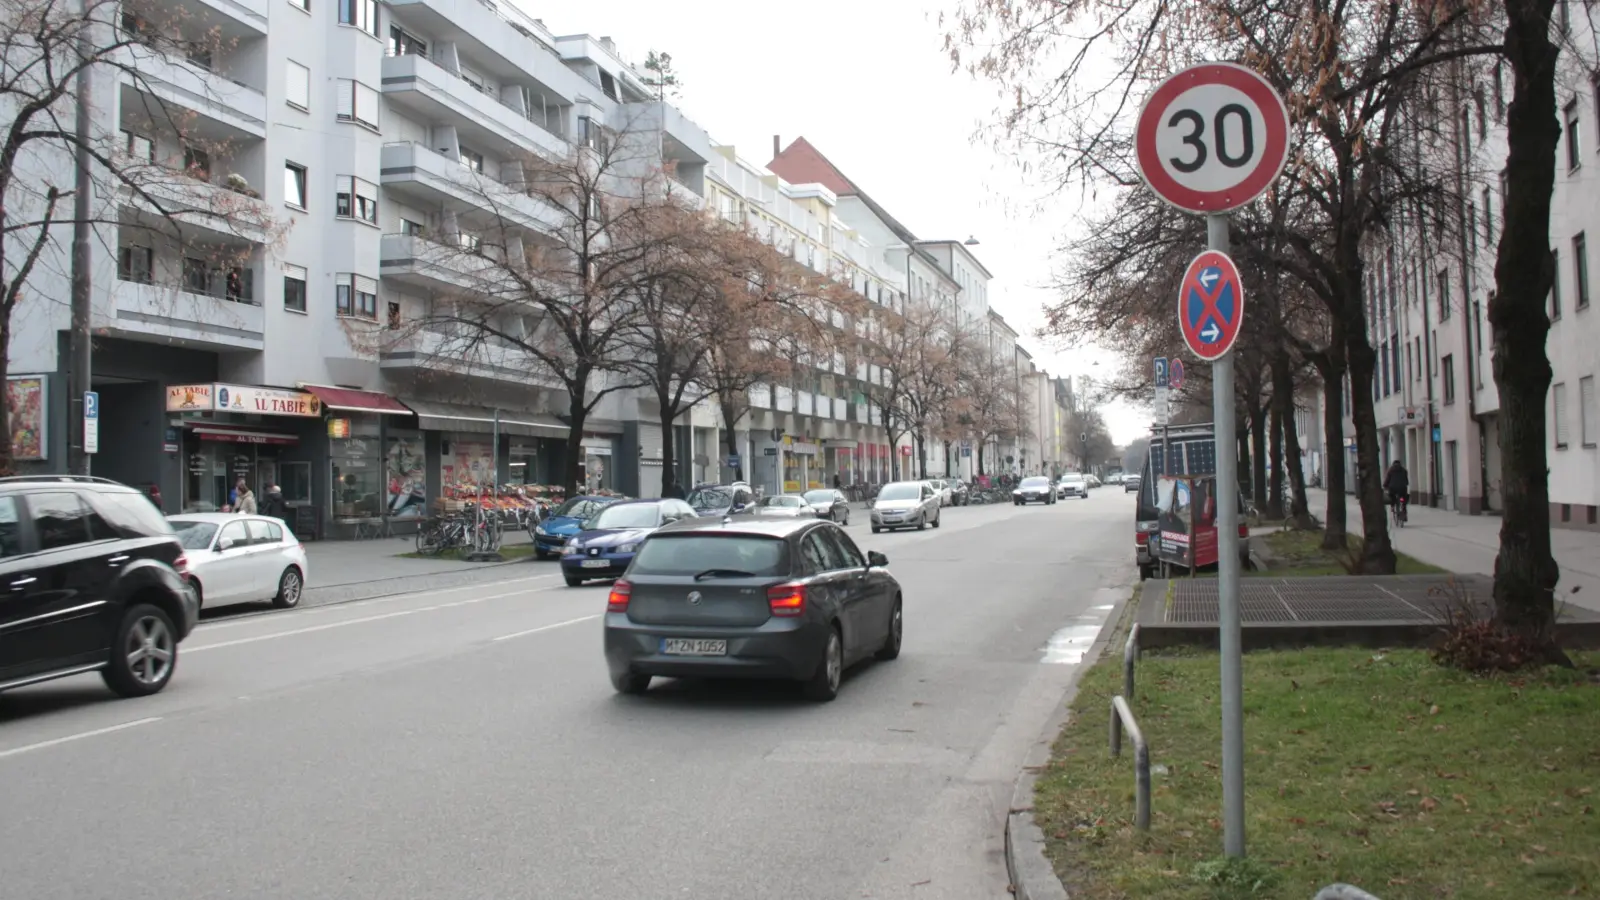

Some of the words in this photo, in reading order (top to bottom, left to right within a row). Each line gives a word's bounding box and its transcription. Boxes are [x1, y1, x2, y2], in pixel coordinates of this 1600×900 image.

[1168, 103, 1254, 173] 30
[1156, 362, 1163, 384] P
[170, 388, 180, 397] AL
[86, 395, 94, 415] P
[697, 641, 725, 653] 1052
